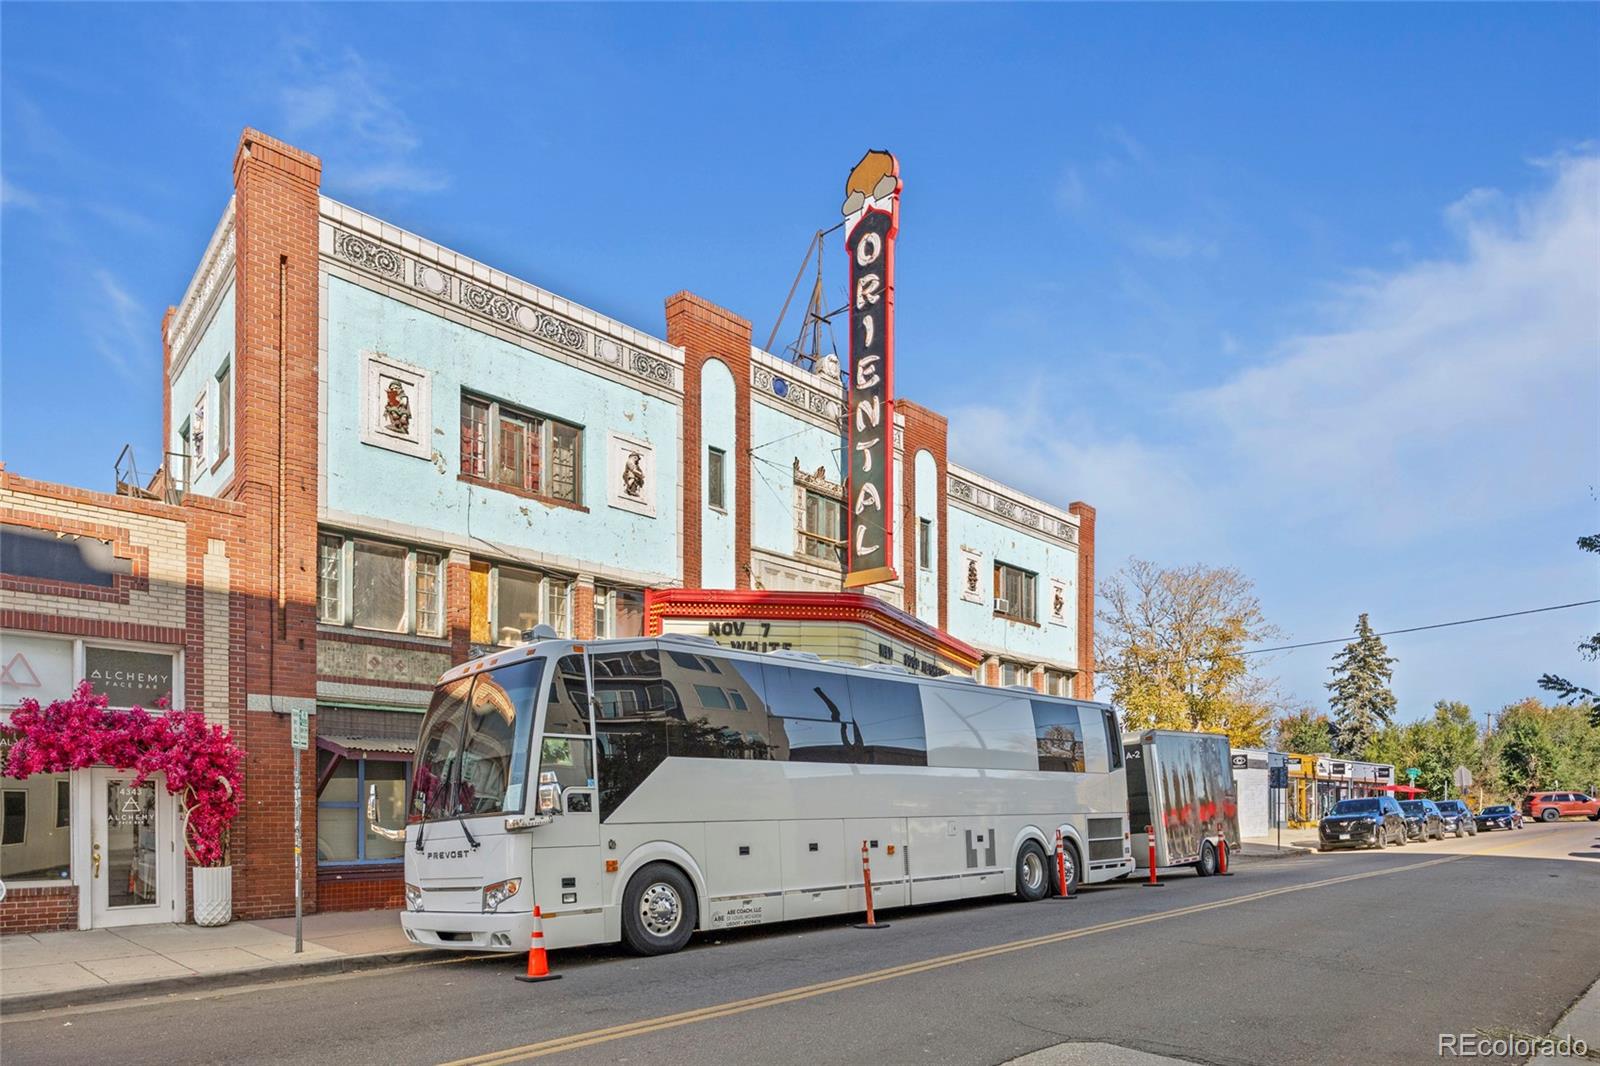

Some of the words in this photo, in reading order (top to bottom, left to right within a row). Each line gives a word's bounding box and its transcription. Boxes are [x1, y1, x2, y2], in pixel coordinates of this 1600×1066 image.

[854, 230, 881, 557] ORIENTAL
[708, 621, 745, 636] NOV
[760, 622, 771, 637] 7
[91, 669, 168, 684] ALCHEMY
[1125, 750, 1141, 760] A-2
[428, 850, 469, 859] PREVOST
